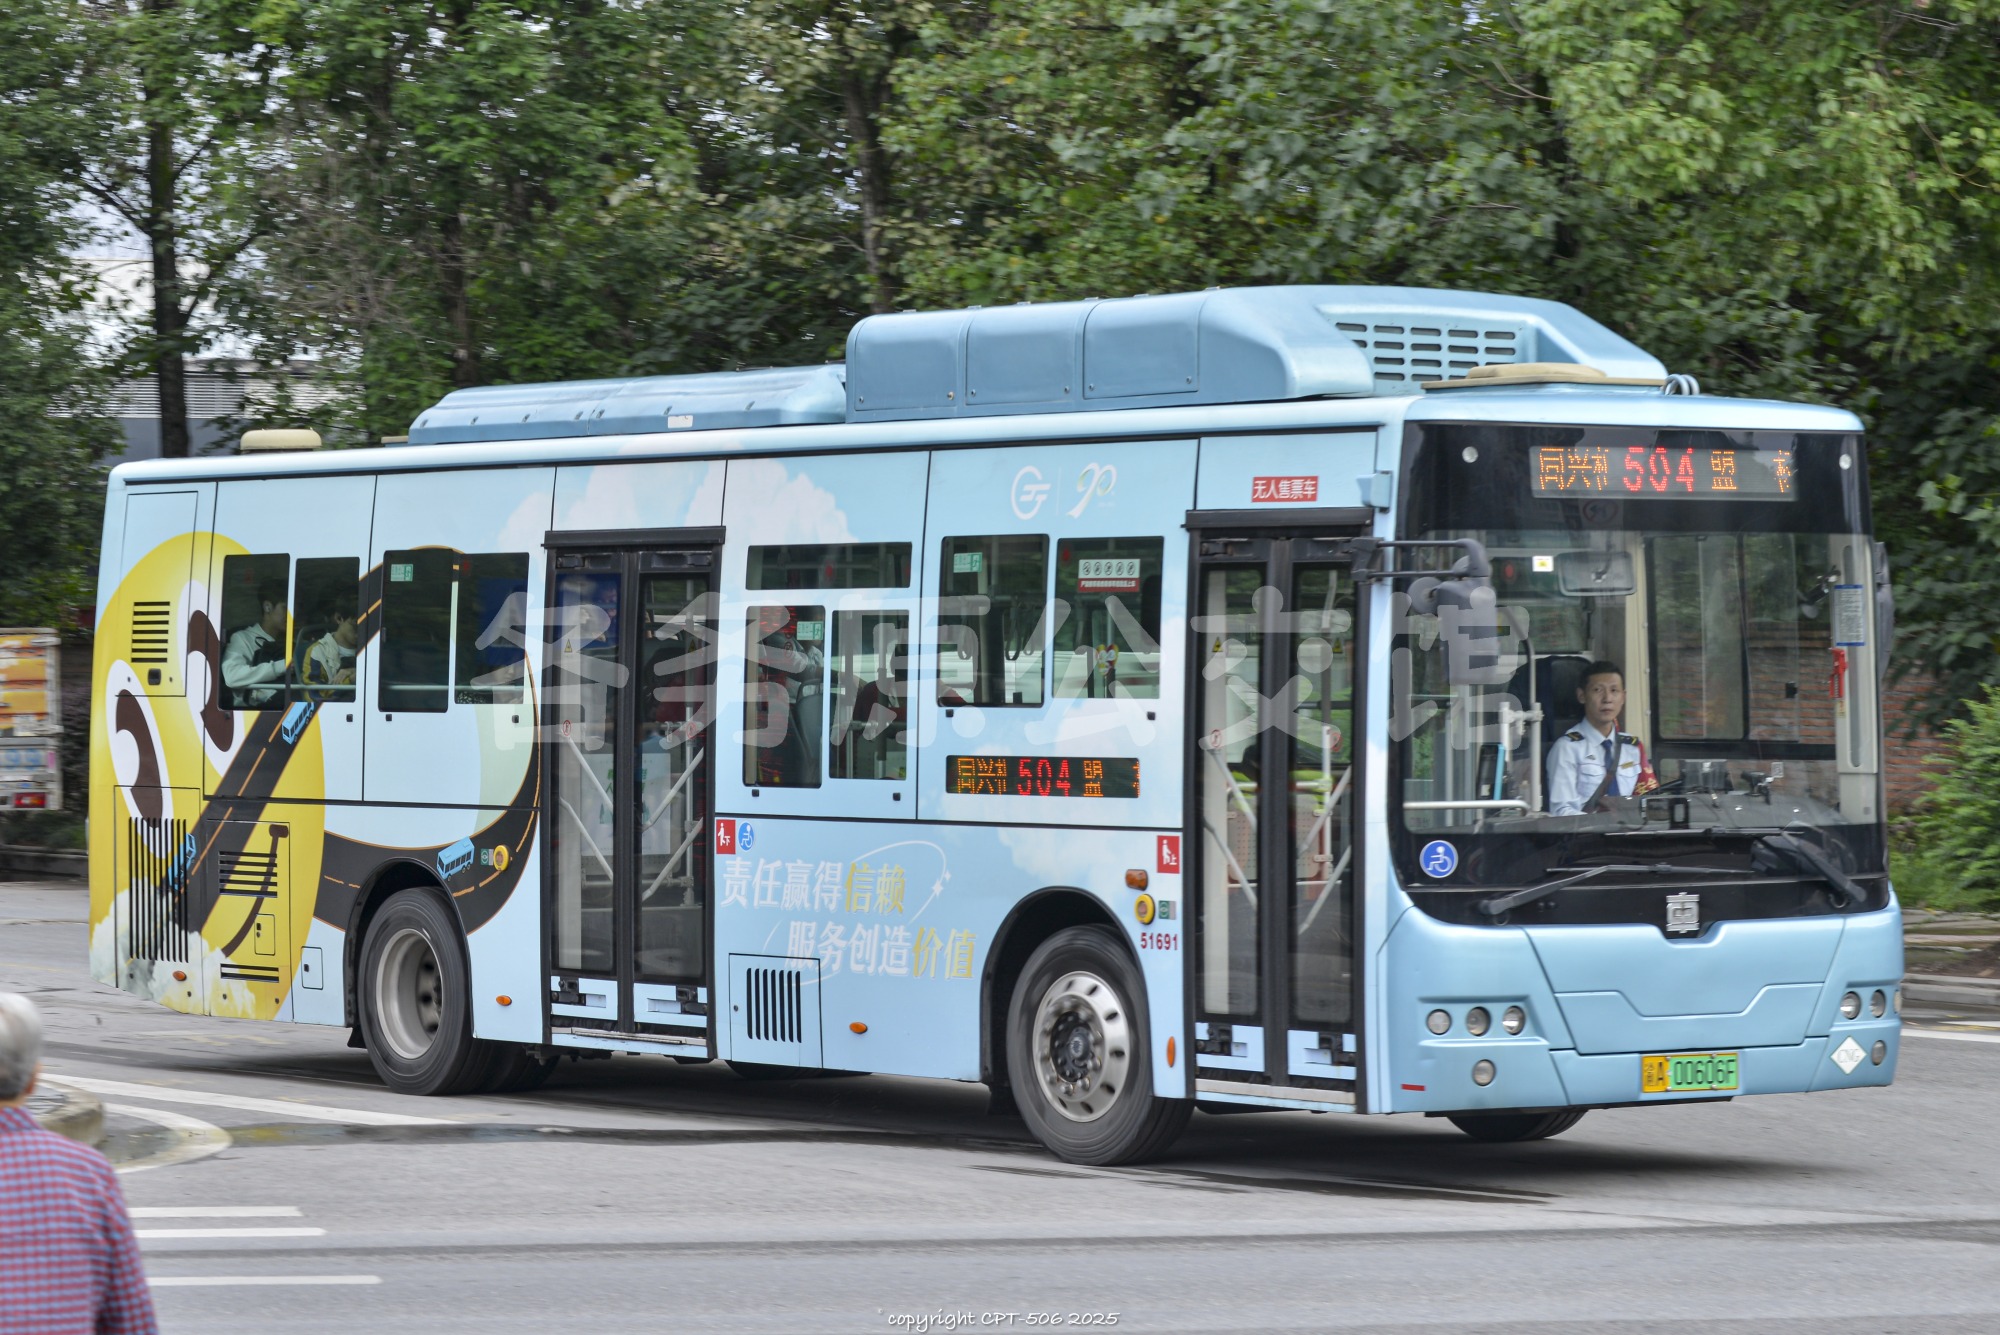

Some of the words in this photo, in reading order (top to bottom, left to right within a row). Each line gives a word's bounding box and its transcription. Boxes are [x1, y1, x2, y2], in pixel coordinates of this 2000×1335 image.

[1253, 479, 1317, 499] 无人售票车
[1623, 446, 1695, 492] 504
[1017, 757, 1072, 797] 504
[720, 857, 906, 915] 责任赢得信赖
[784, 920, 977, 980] 服务创造价值
[1140, 932, 1178, 951] 51691
[1837, 1048, 1860, 1064] CNG
